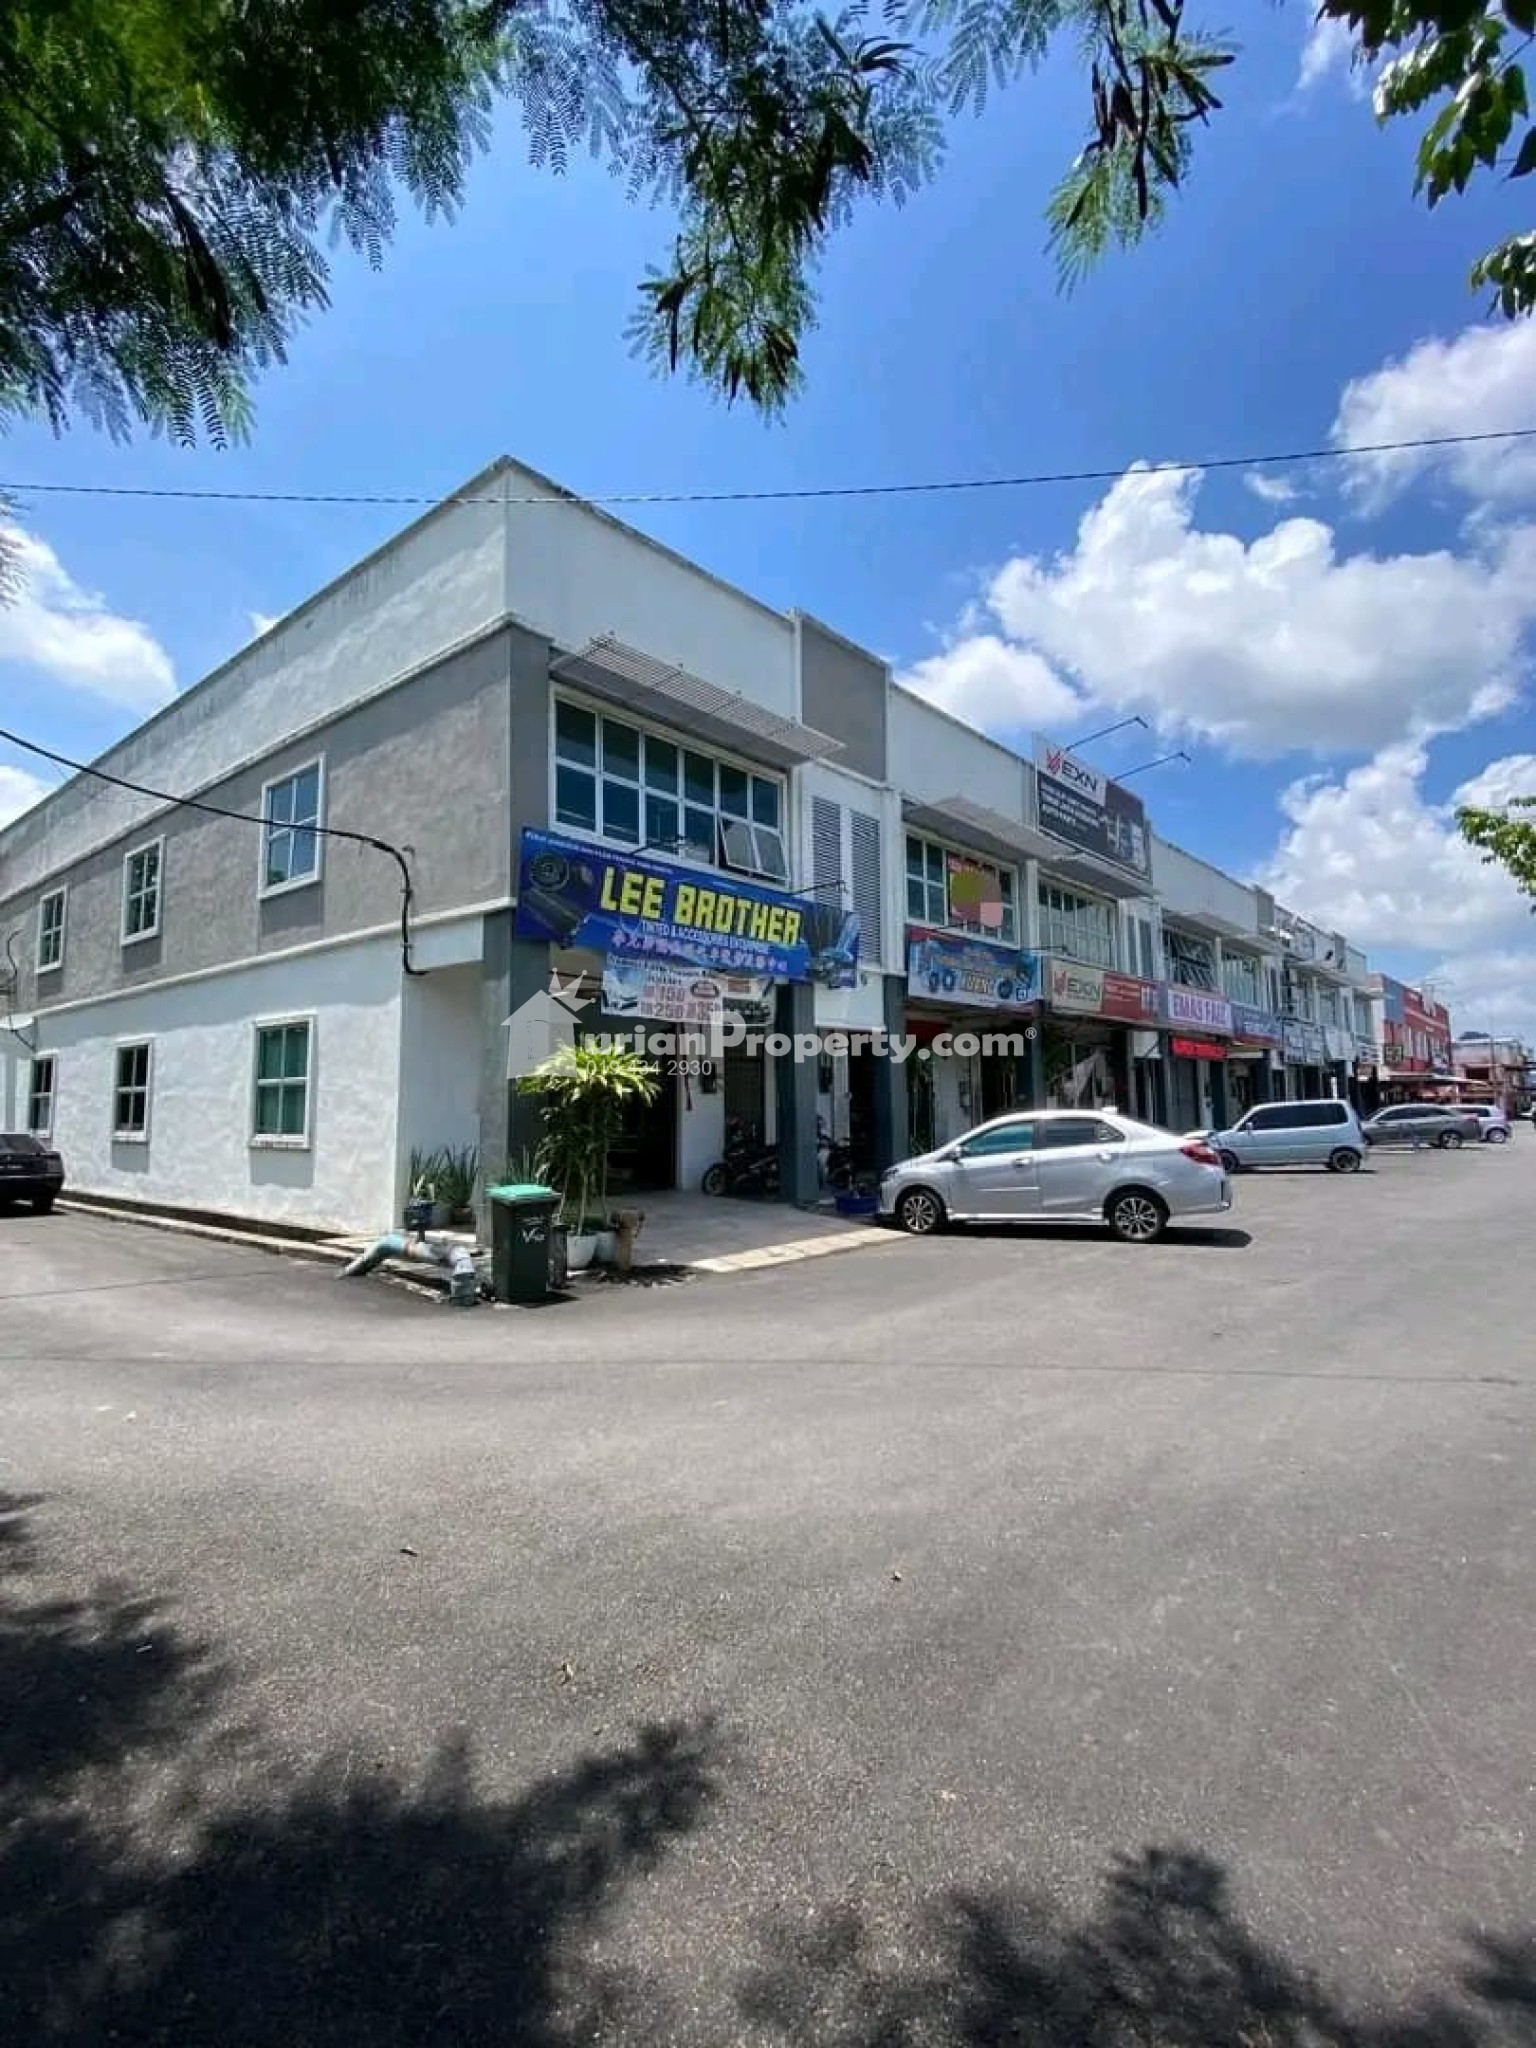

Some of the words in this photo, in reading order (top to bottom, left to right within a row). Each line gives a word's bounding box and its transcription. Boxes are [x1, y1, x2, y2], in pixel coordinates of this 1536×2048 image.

[600, 866, 665, 920] LEE
[674, 884, 802, 947] BROTHER
[1173, 993, 1202, 1021] EMAS
